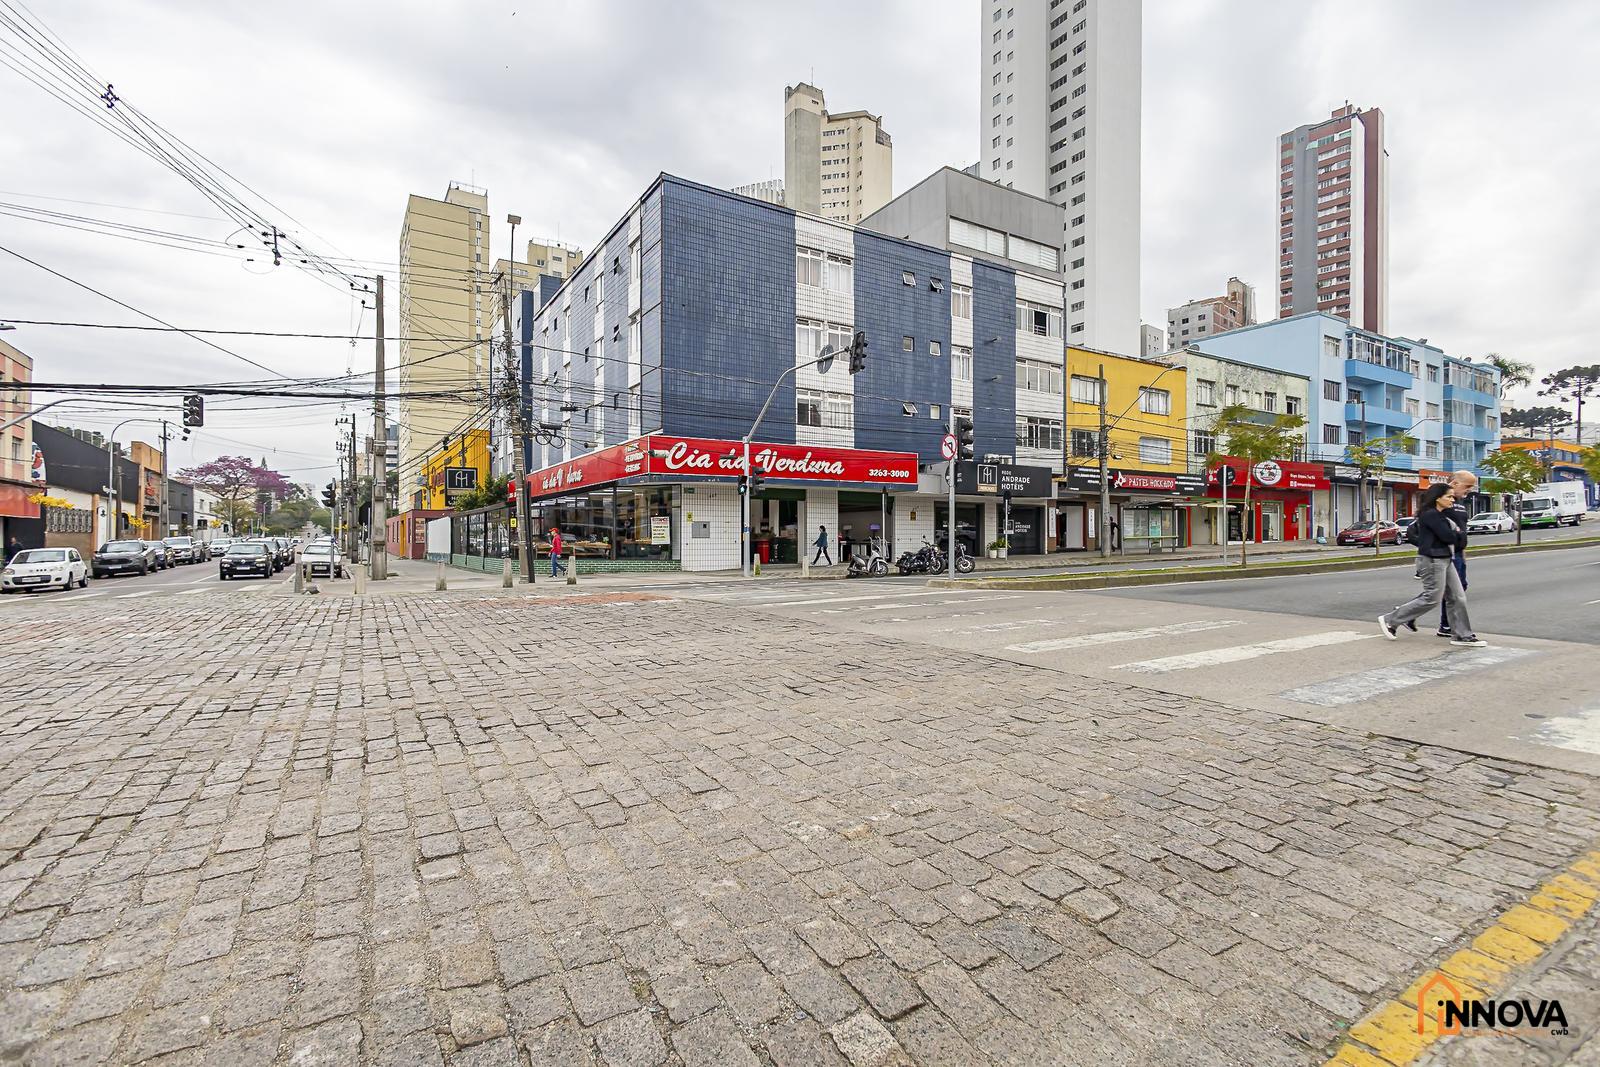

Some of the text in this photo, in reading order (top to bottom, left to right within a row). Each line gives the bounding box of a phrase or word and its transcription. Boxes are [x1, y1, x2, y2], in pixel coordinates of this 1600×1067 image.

[665, 442, 845, 475] Cia da Verdura
[868, 468, 910, 478] 3263-3000
[1001, 475, 1031, 484] ANDRADE
